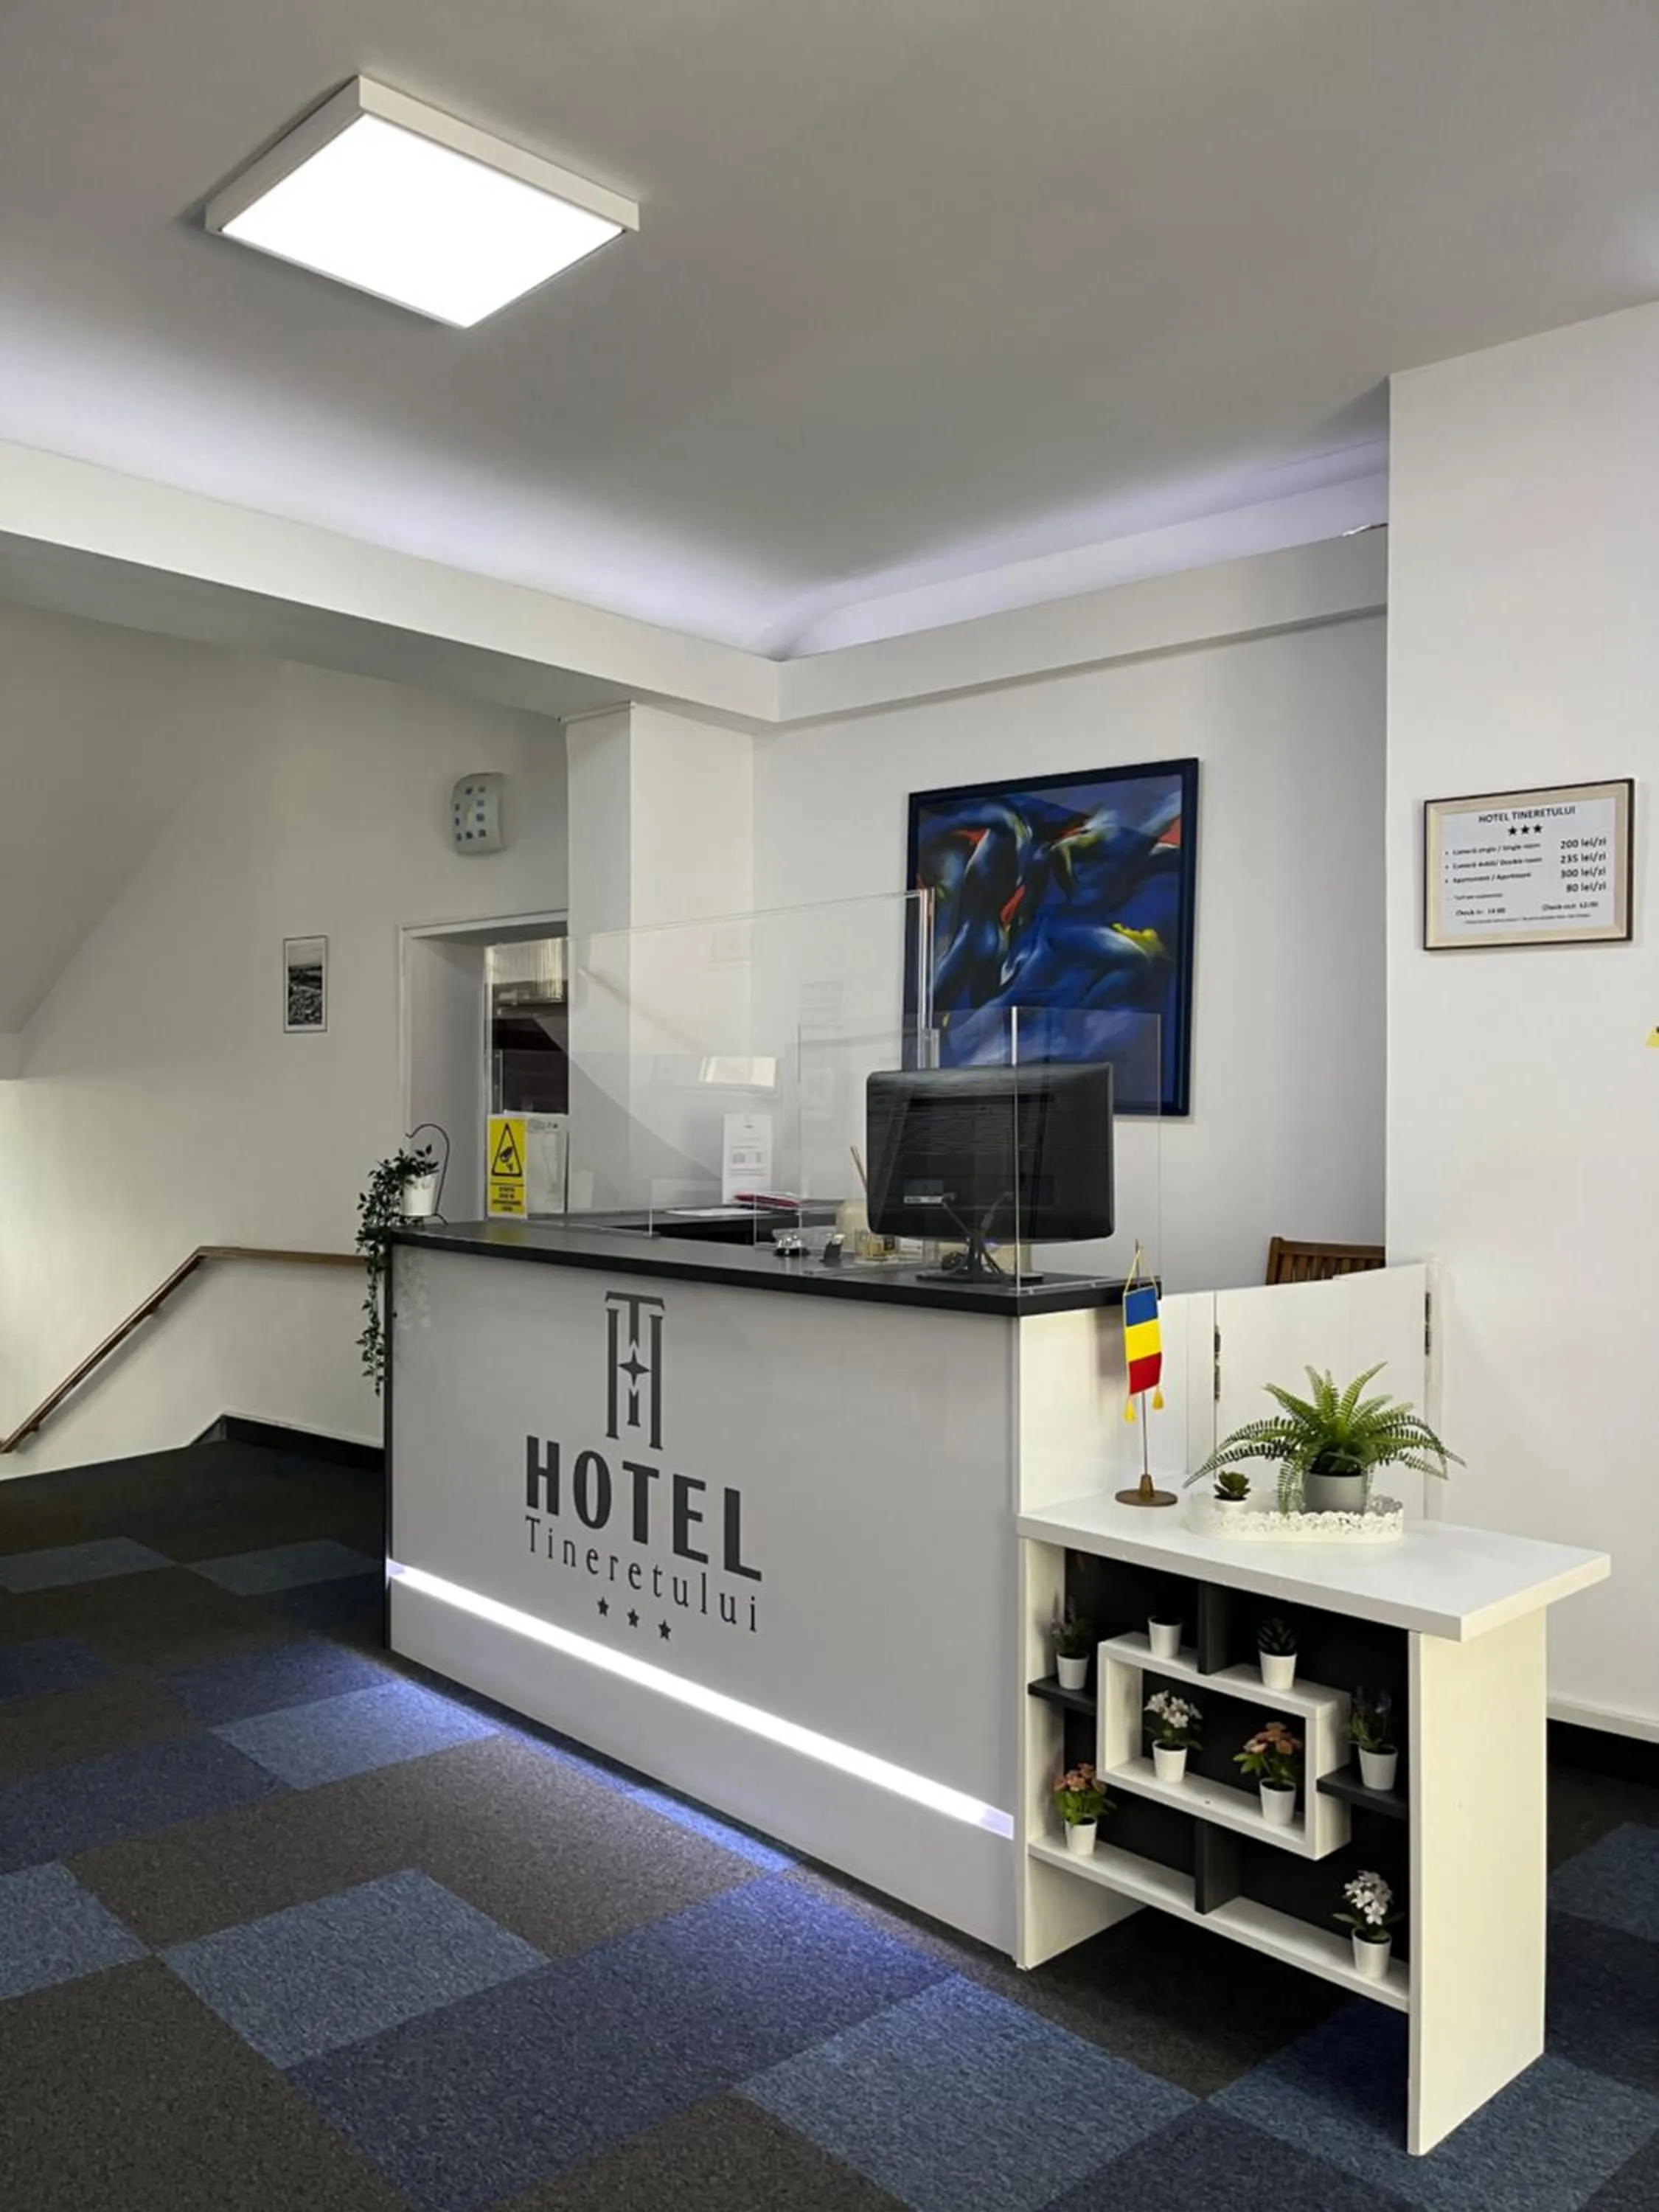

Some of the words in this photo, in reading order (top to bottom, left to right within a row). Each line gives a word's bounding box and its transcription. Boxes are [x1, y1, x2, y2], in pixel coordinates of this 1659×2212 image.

[1478, 813, 1509, 823] HOTEL
[1512, 805, 1576, 821] TINERETULUI
[1560, 838, 1579, 849] 200
[1580, 835, 1607, 848] lei/zi
[1560, 853, 1579, 864] 235
[1580, 851, 1607, 863] lei/zi
[1560, 869, 1579, 879] 300
[1580, 866, 1607, 877] lei/zi
[1565, 883, 1579, 893] 80
[1580, 880, 1607, 892] lei/zi
[526, 1435, 762, 1582] HOTEL
[525, 1514, 757, 1632] Tineretului
